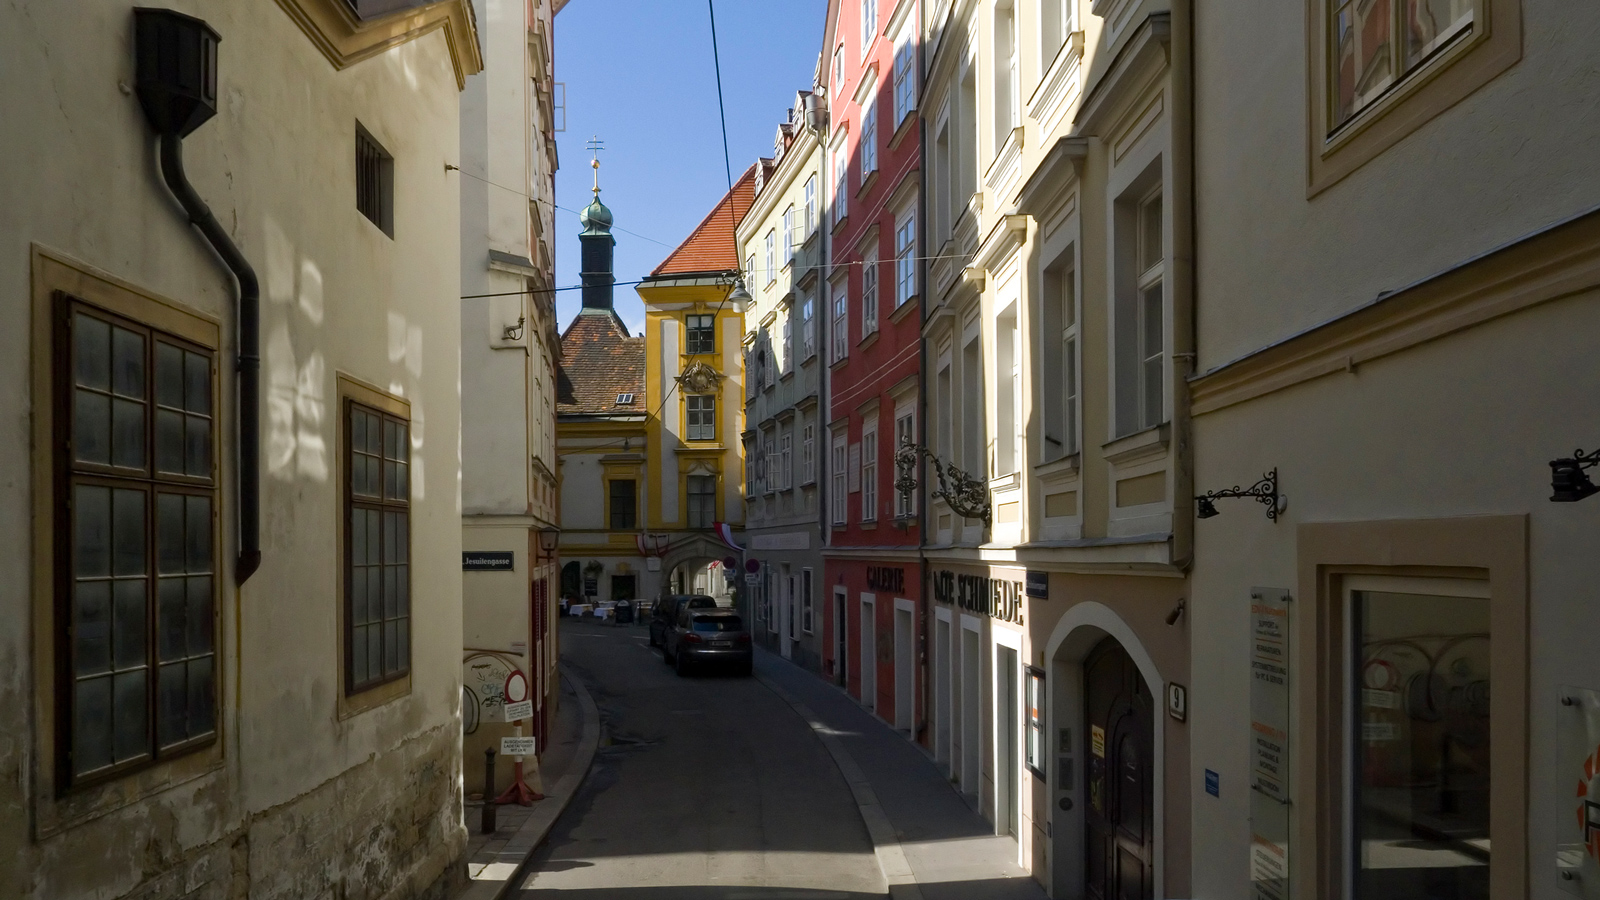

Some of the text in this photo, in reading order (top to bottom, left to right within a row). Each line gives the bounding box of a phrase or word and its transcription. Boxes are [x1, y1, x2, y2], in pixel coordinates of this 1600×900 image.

[465, 557, 510, 567] Jesuitengasse
[867, 566, 905, 594] GALERIE
[957, 573, 1024, 627] SCHMIEDE
[1174, 687, 1180, 708] 9
[1257, 737, 1281, 753] INSTALLATION
